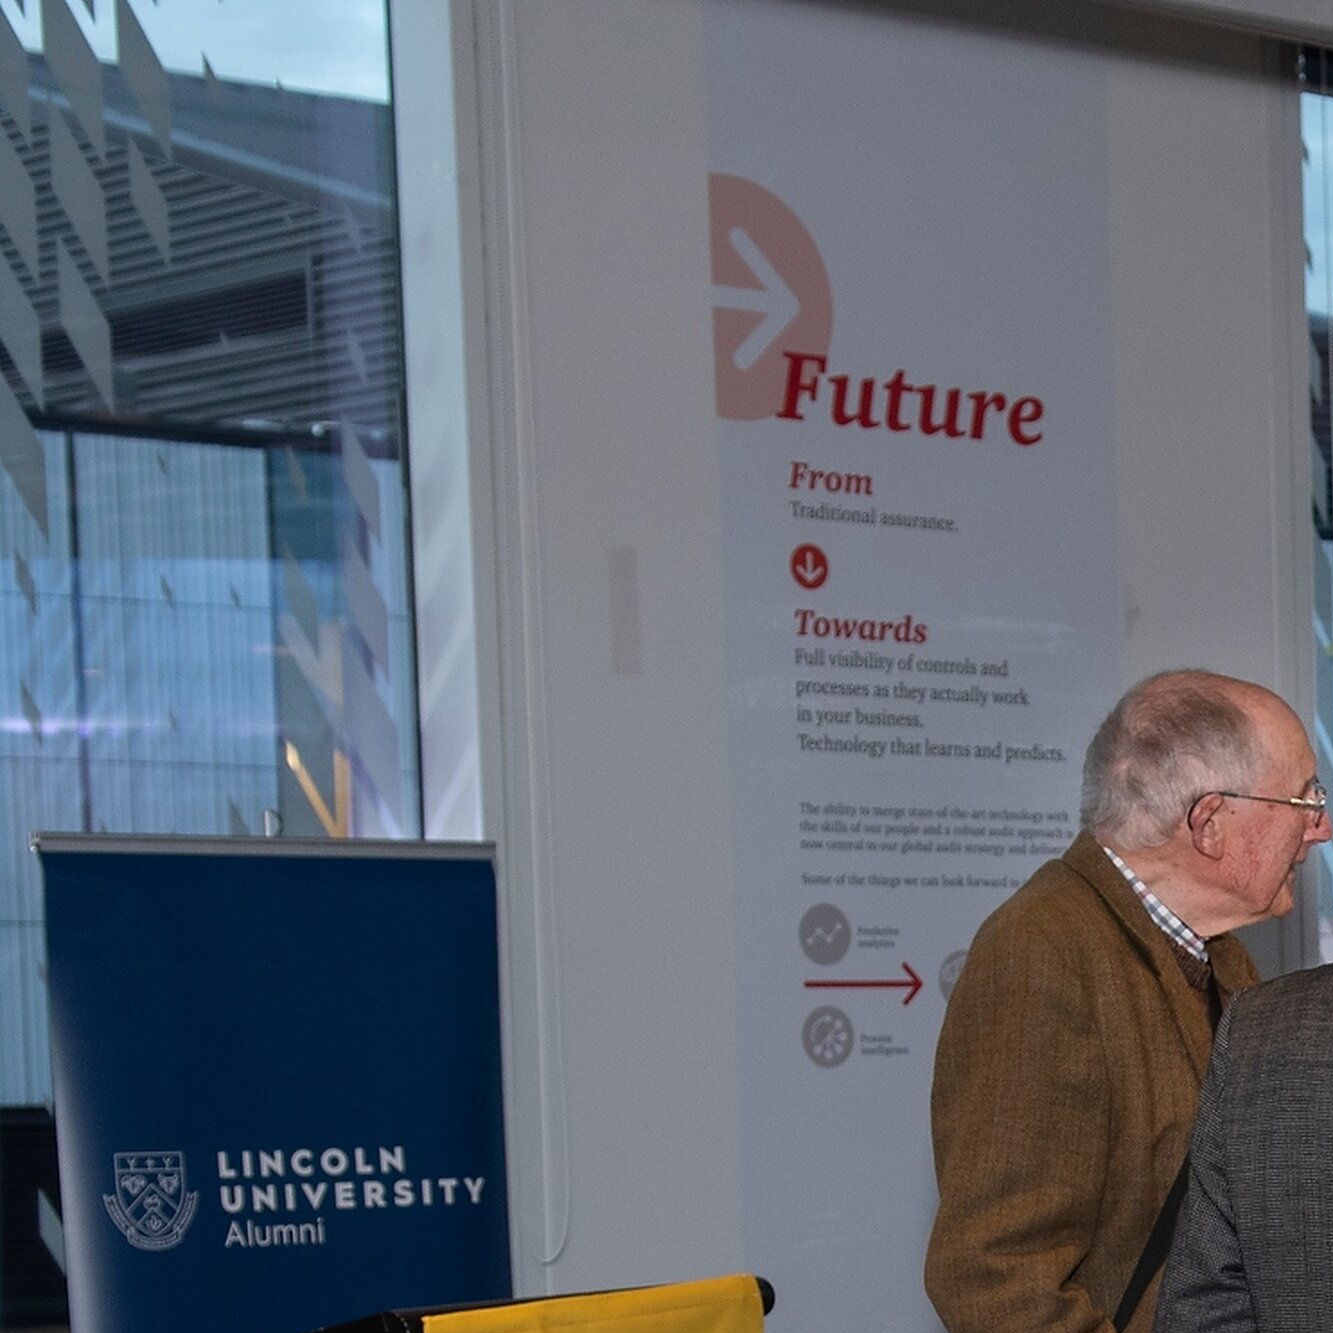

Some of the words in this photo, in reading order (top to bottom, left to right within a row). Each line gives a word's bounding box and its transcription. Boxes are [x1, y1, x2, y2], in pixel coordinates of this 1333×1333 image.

[776, 352, 1045, 446] Future
[788, 462, 874, 496] From
[789, 500, 876, 525] Traditional
[880, 511, 959, 533] assurance.
[794, 609, 929, 644] Towards
[795, 648, 825, 666] Full
[828, 651, 895, 673] visibility
[898, 655, 914, 672] of
[916, 657, 978, 676] controls
[981, 660, 1009, 677] and
[795, 681, 869, 698] processes
[873, 684, 889, 698] as
[893, 682, 926, 705] they
[929, 685, 989, 707] actually
[991, 687, 1030, 706] work
[796, 705, 812, 722] in
[816, 709, 853, 727] your
[855, 708, 925, 729] business.
[797, 733, 887, 760] Technology
[890, 738, 922, 757] that
[925, 738, 972, 759] learns
[974, 743, 1002, 761] and
[1005, 745, 1068, 764] predicts.
[800, 802, 820, 814] The
[217, 1146, 406, 1179] LINCOLN
[220, 1177, 486, 1213] UNIVERSITY
[224, 1217, 326, 1248] Alumni
